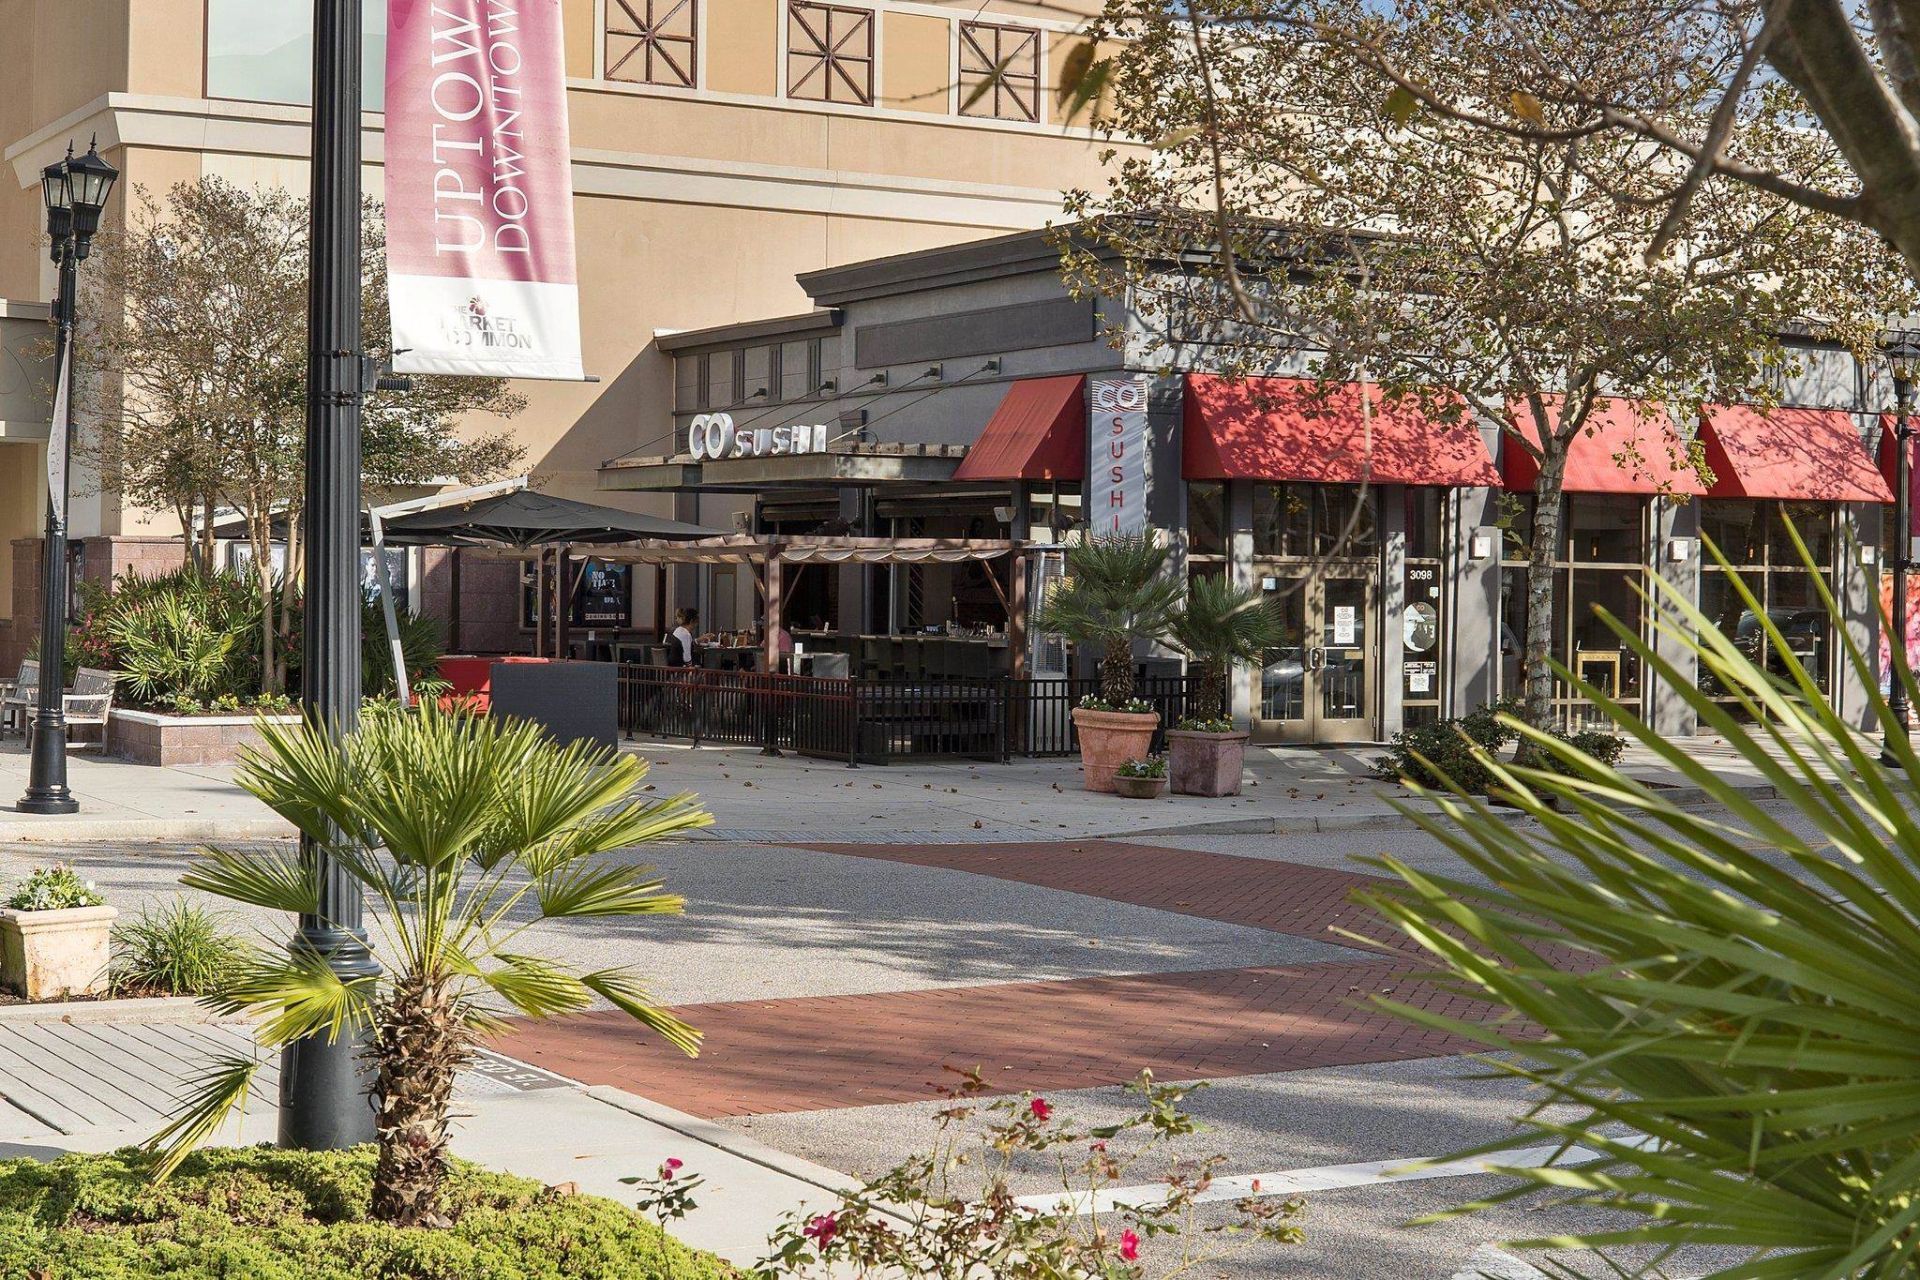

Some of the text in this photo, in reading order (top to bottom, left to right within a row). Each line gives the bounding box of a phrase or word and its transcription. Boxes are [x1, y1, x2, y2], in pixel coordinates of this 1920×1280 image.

[431, 0, 485, 255] UPTOW
[438, 315, 517, 332] ARKET
[1098, 384, 1139, 408] CO
[689, 412, 735, 459] CO
[1110, 417, 1124, 531] SUSHI
[1410, 570, 1432, 580] 3098
